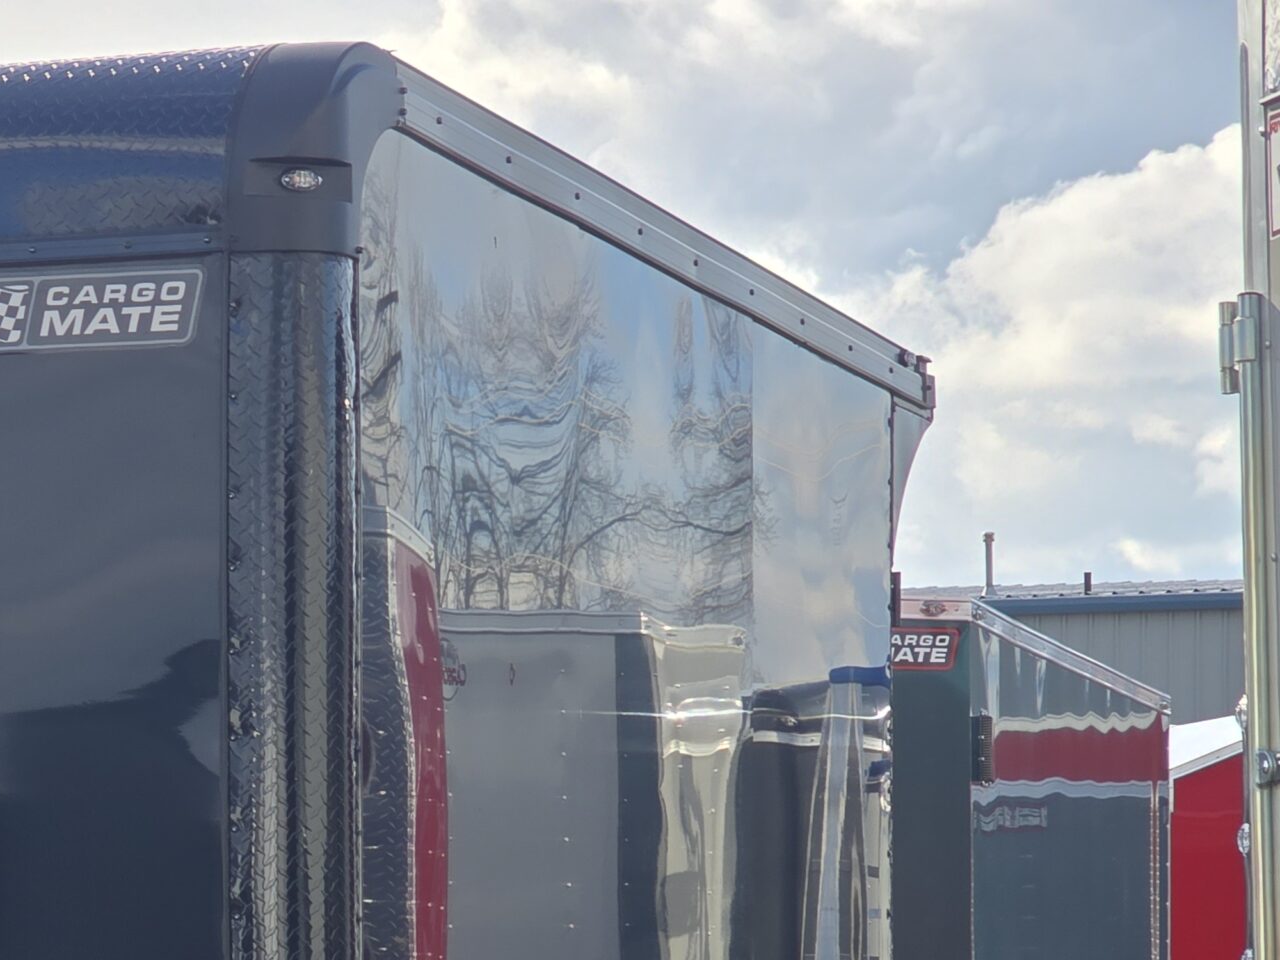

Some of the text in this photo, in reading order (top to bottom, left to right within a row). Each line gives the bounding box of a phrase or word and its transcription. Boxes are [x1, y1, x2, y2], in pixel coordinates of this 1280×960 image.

[46, 281, 186, 306] CARGO
[40, 304, 182, 337] MATE
[891, 634, 950, 646] ARGO
[891, 647, 948, 663] ATE
